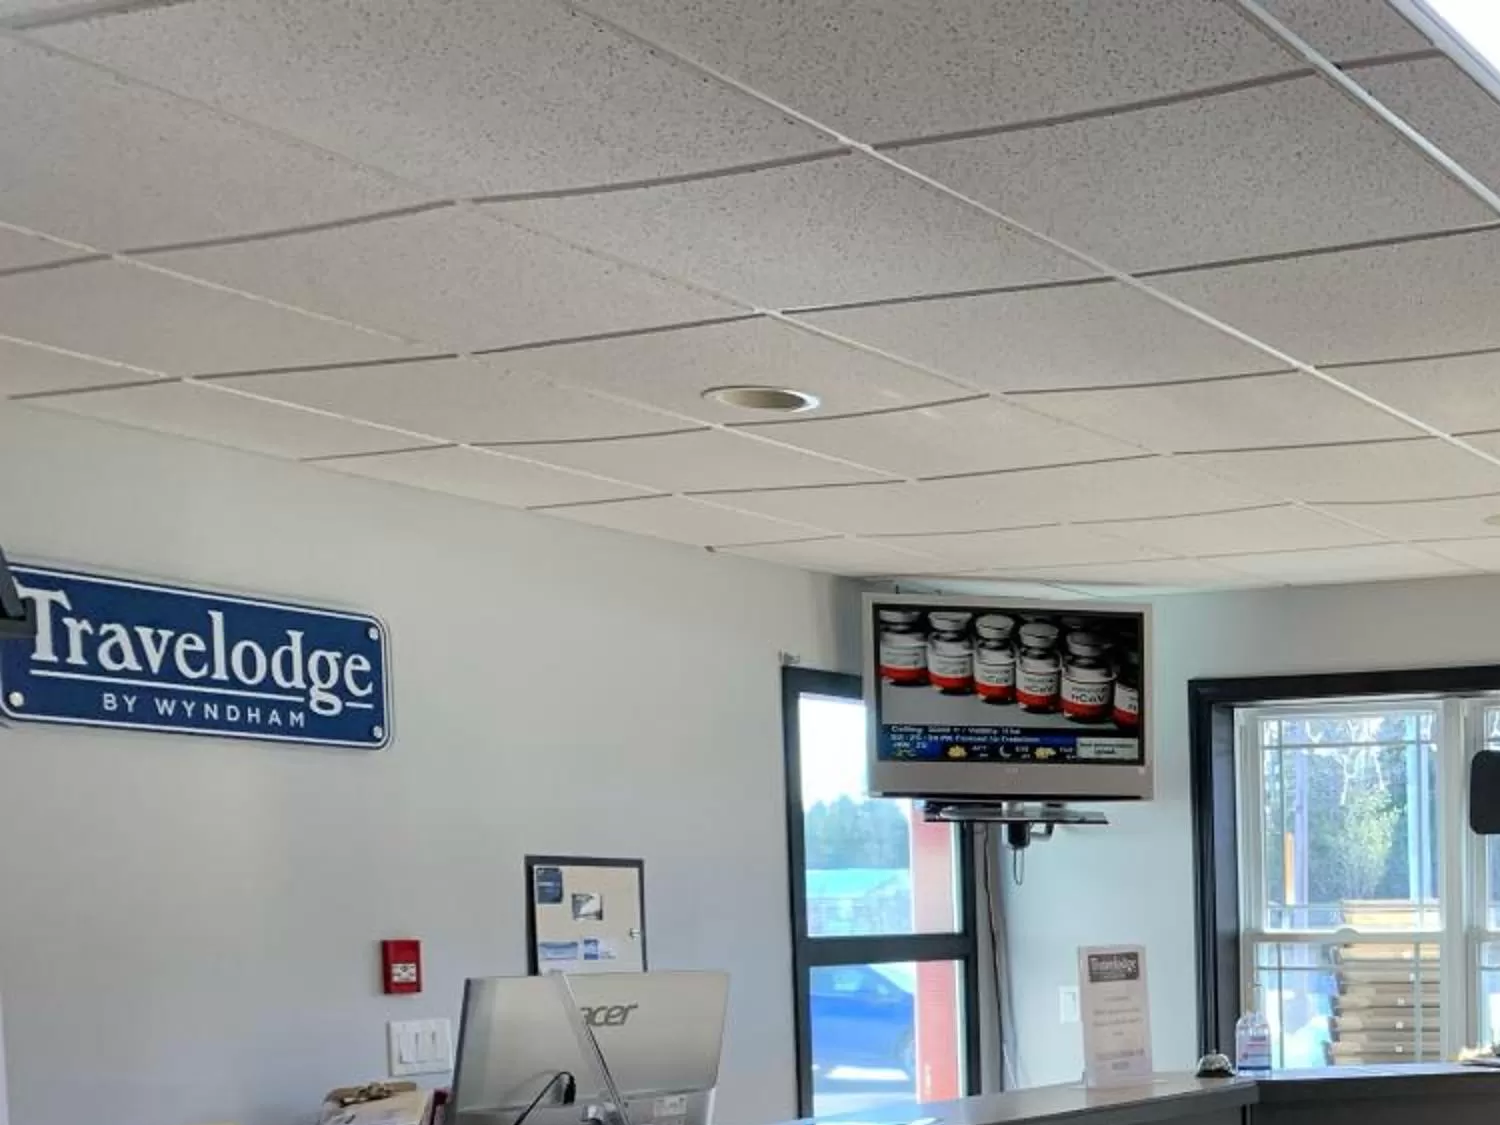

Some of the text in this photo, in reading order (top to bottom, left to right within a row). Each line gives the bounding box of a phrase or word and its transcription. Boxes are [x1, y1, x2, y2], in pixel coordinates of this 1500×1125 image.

[15, 577, 374, 716] Travelodge
[103, 693, 306, 728] BY WYNDHAM
[580, 1001, 639, 1027] acer
